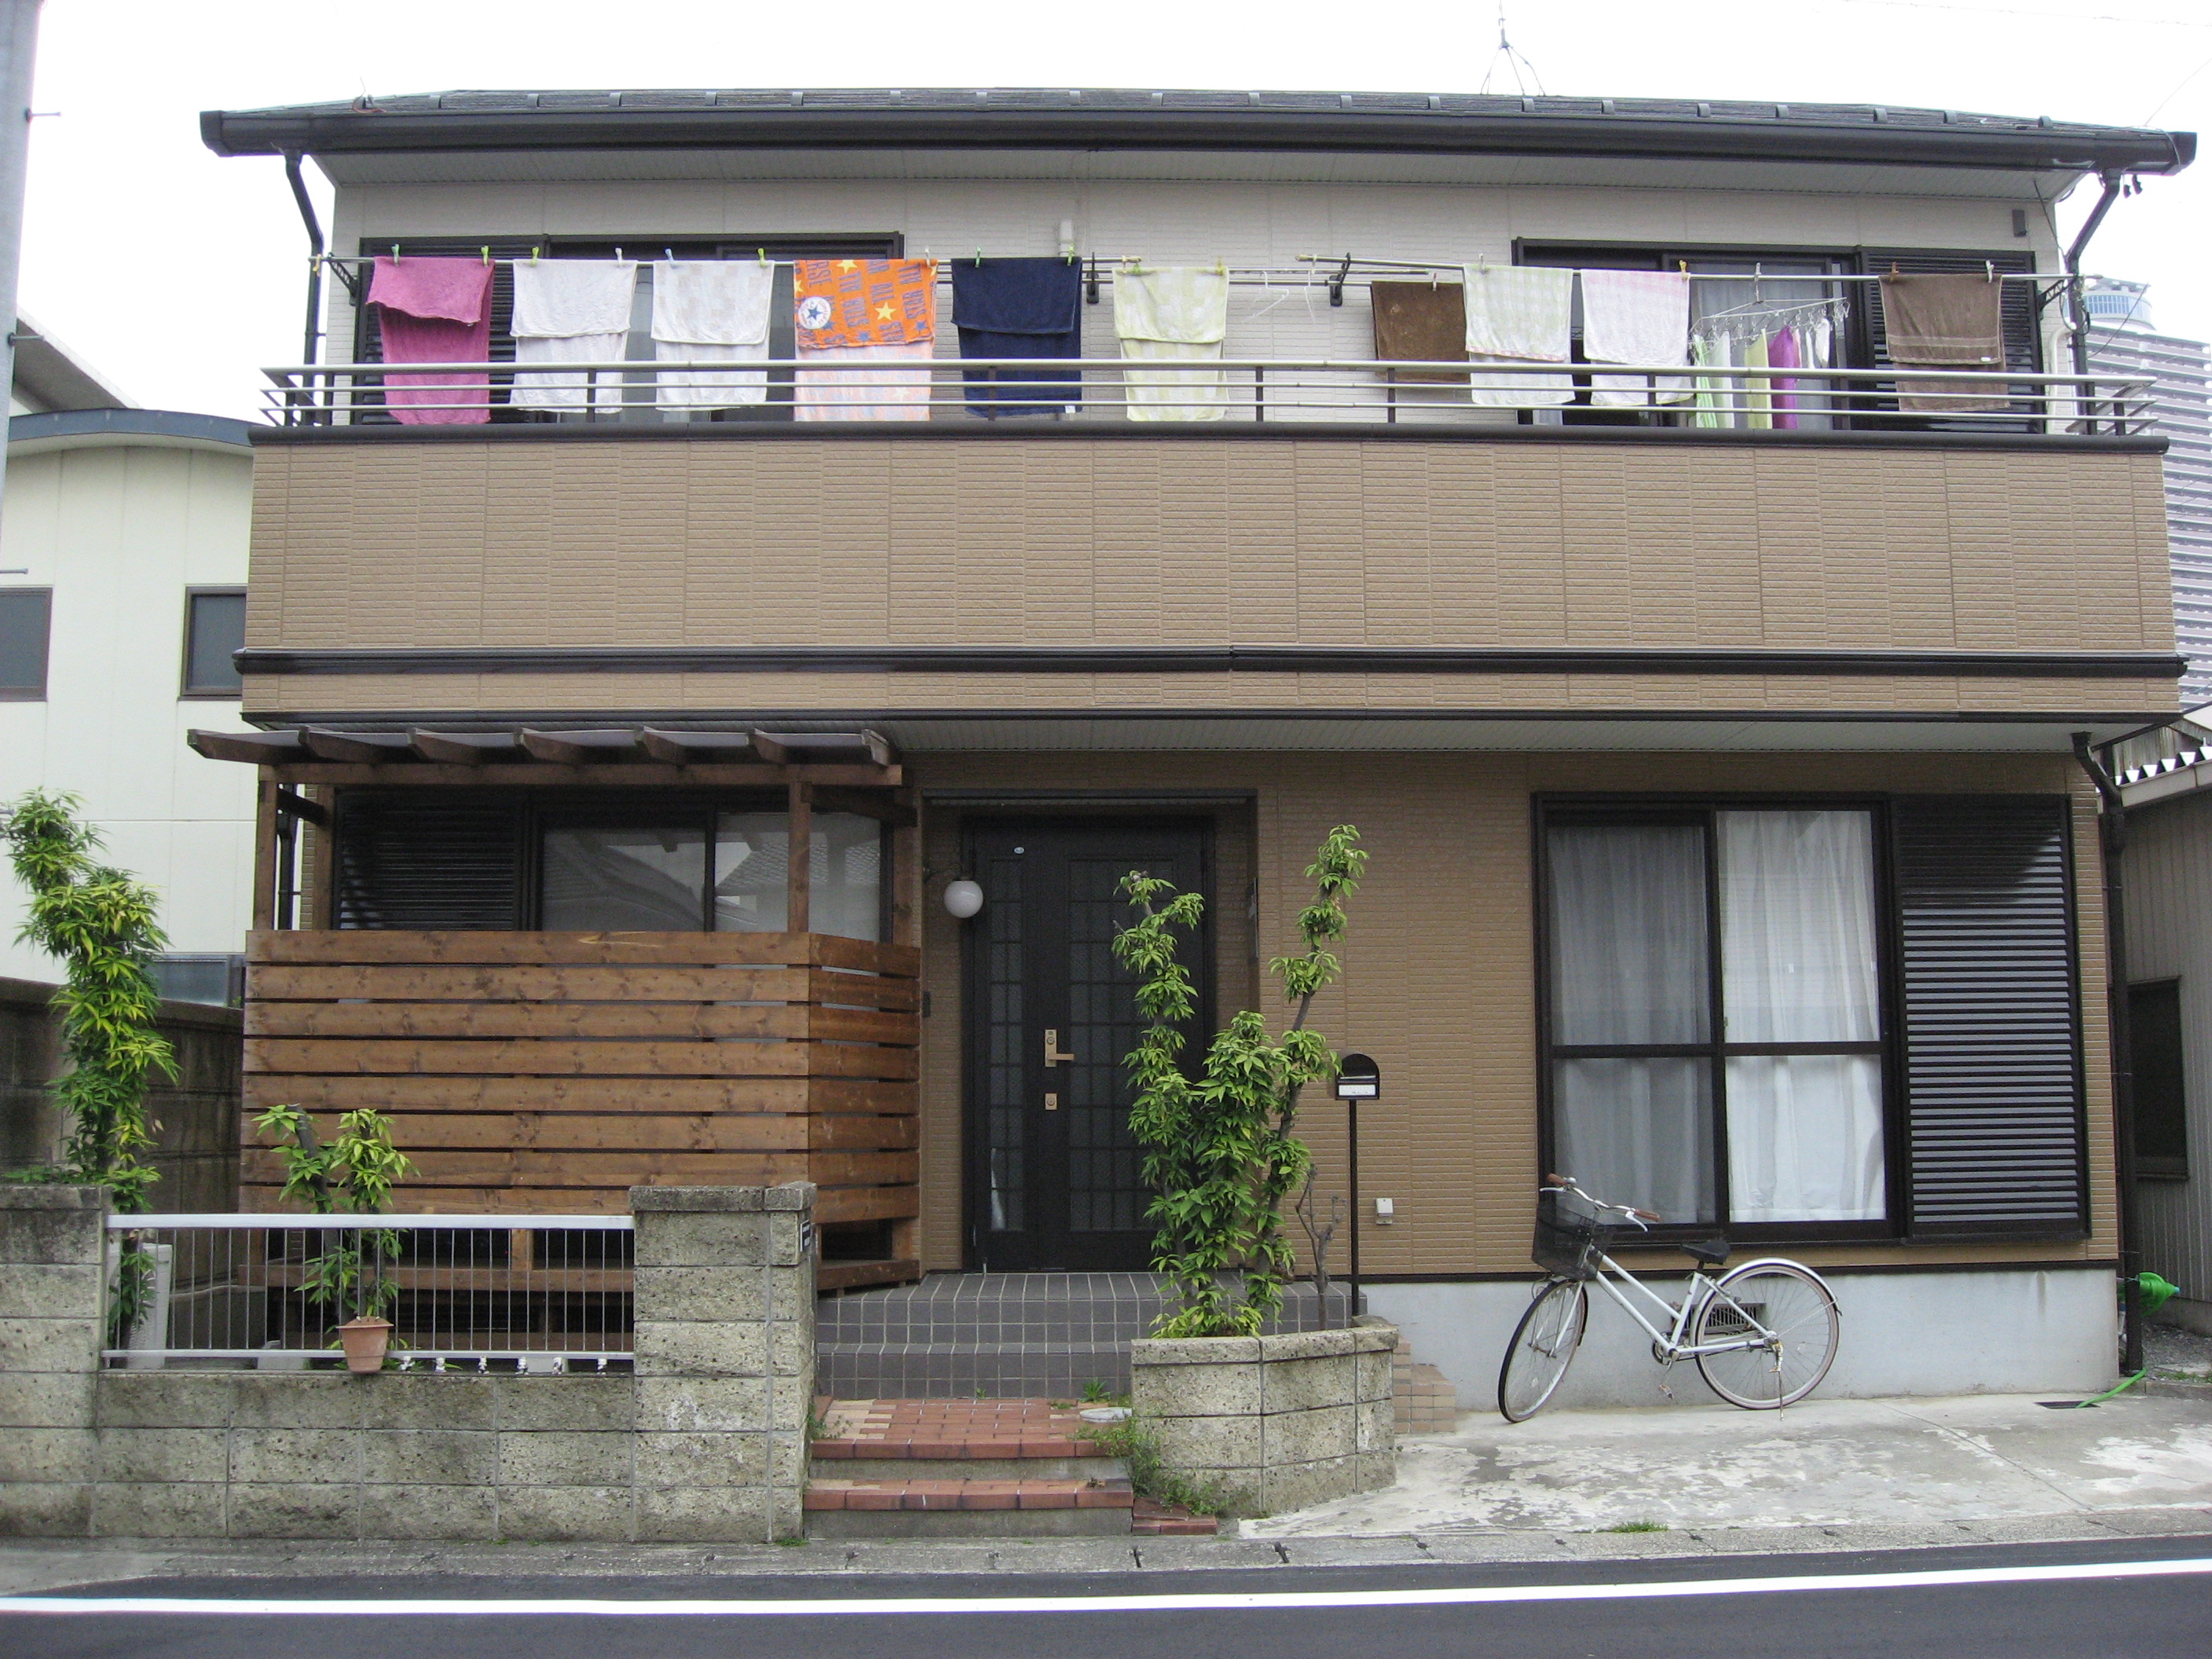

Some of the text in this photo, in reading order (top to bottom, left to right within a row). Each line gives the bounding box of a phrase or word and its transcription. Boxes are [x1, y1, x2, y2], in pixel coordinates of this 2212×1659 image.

[838, 271, 870, 328] STAR ALL
[870, 282, 895, 304] ALL
[898, 263, 927, 320] STAR ALL
